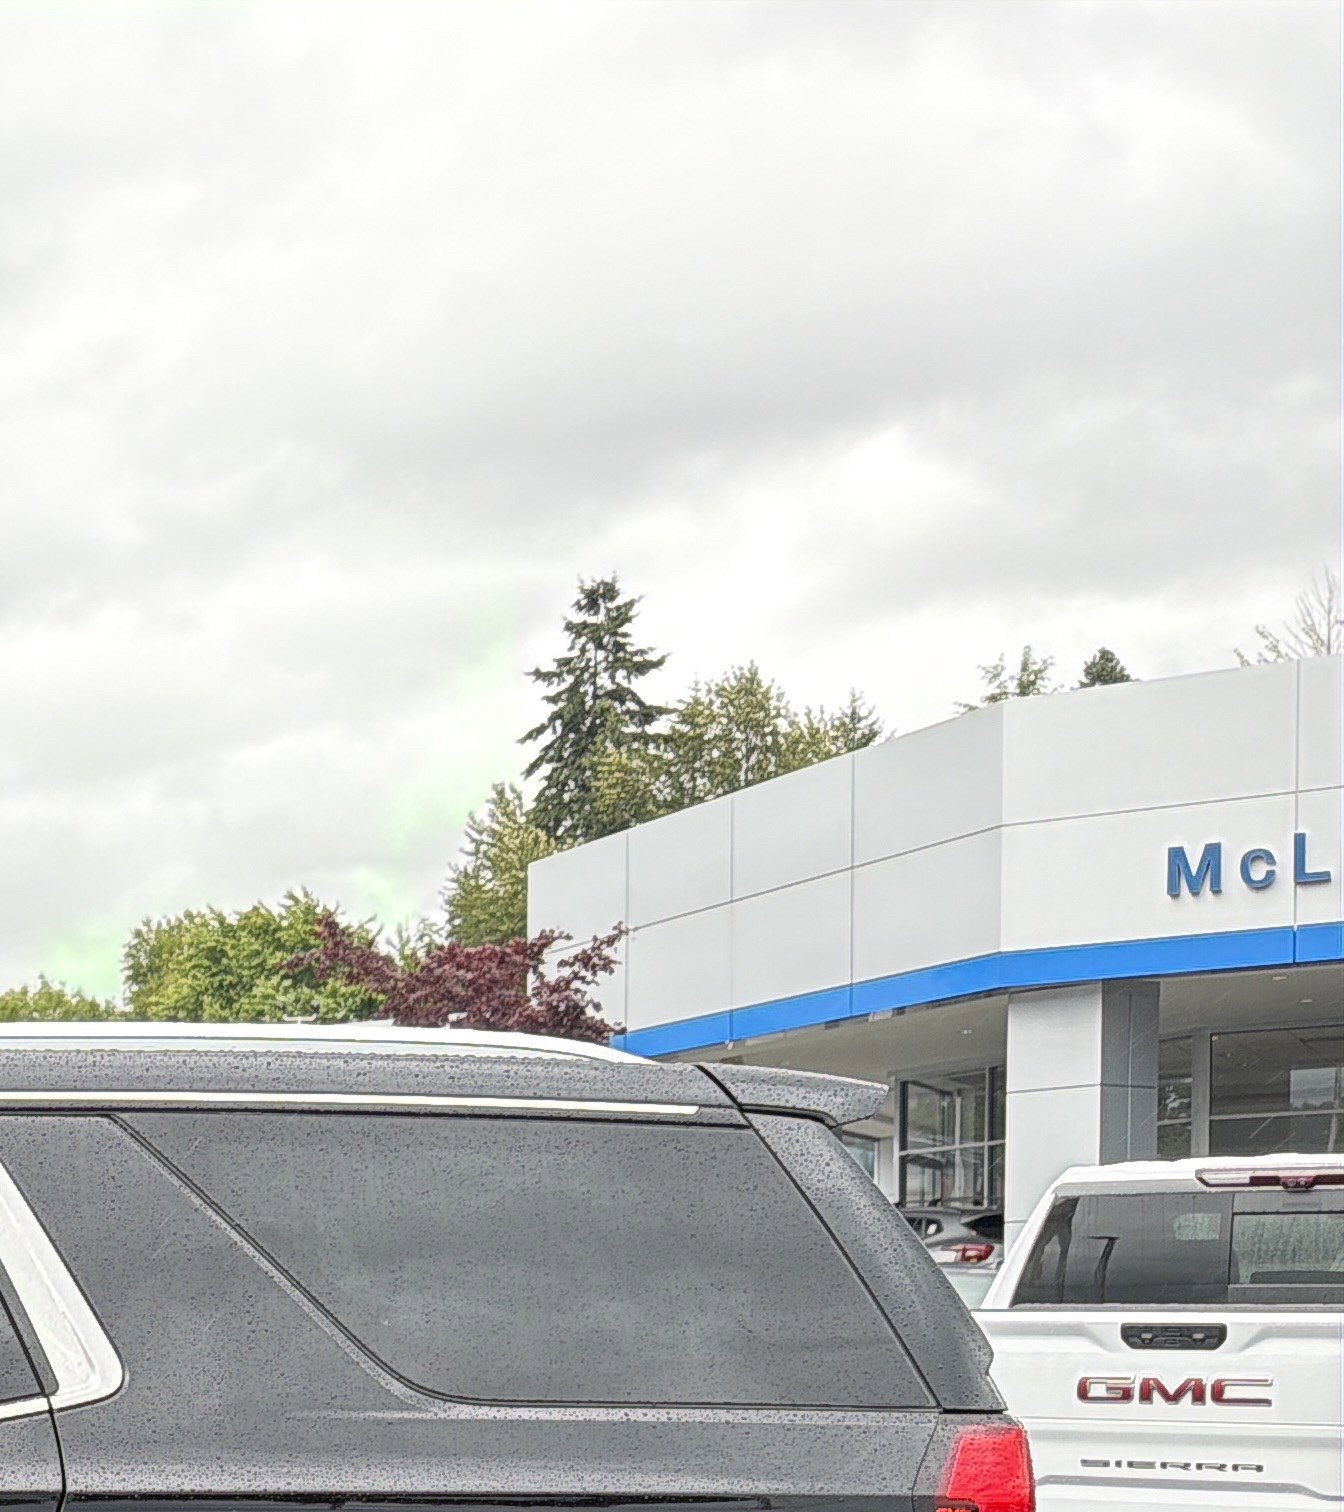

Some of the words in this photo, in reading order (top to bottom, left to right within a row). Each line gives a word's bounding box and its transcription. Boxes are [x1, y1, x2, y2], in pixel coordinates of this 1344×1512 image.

[1167, 832, 1331, 897] McL
[1076, 1376, 1274, 1407] GMC
[1080, 1458, 1264, 1473] SIERRA
